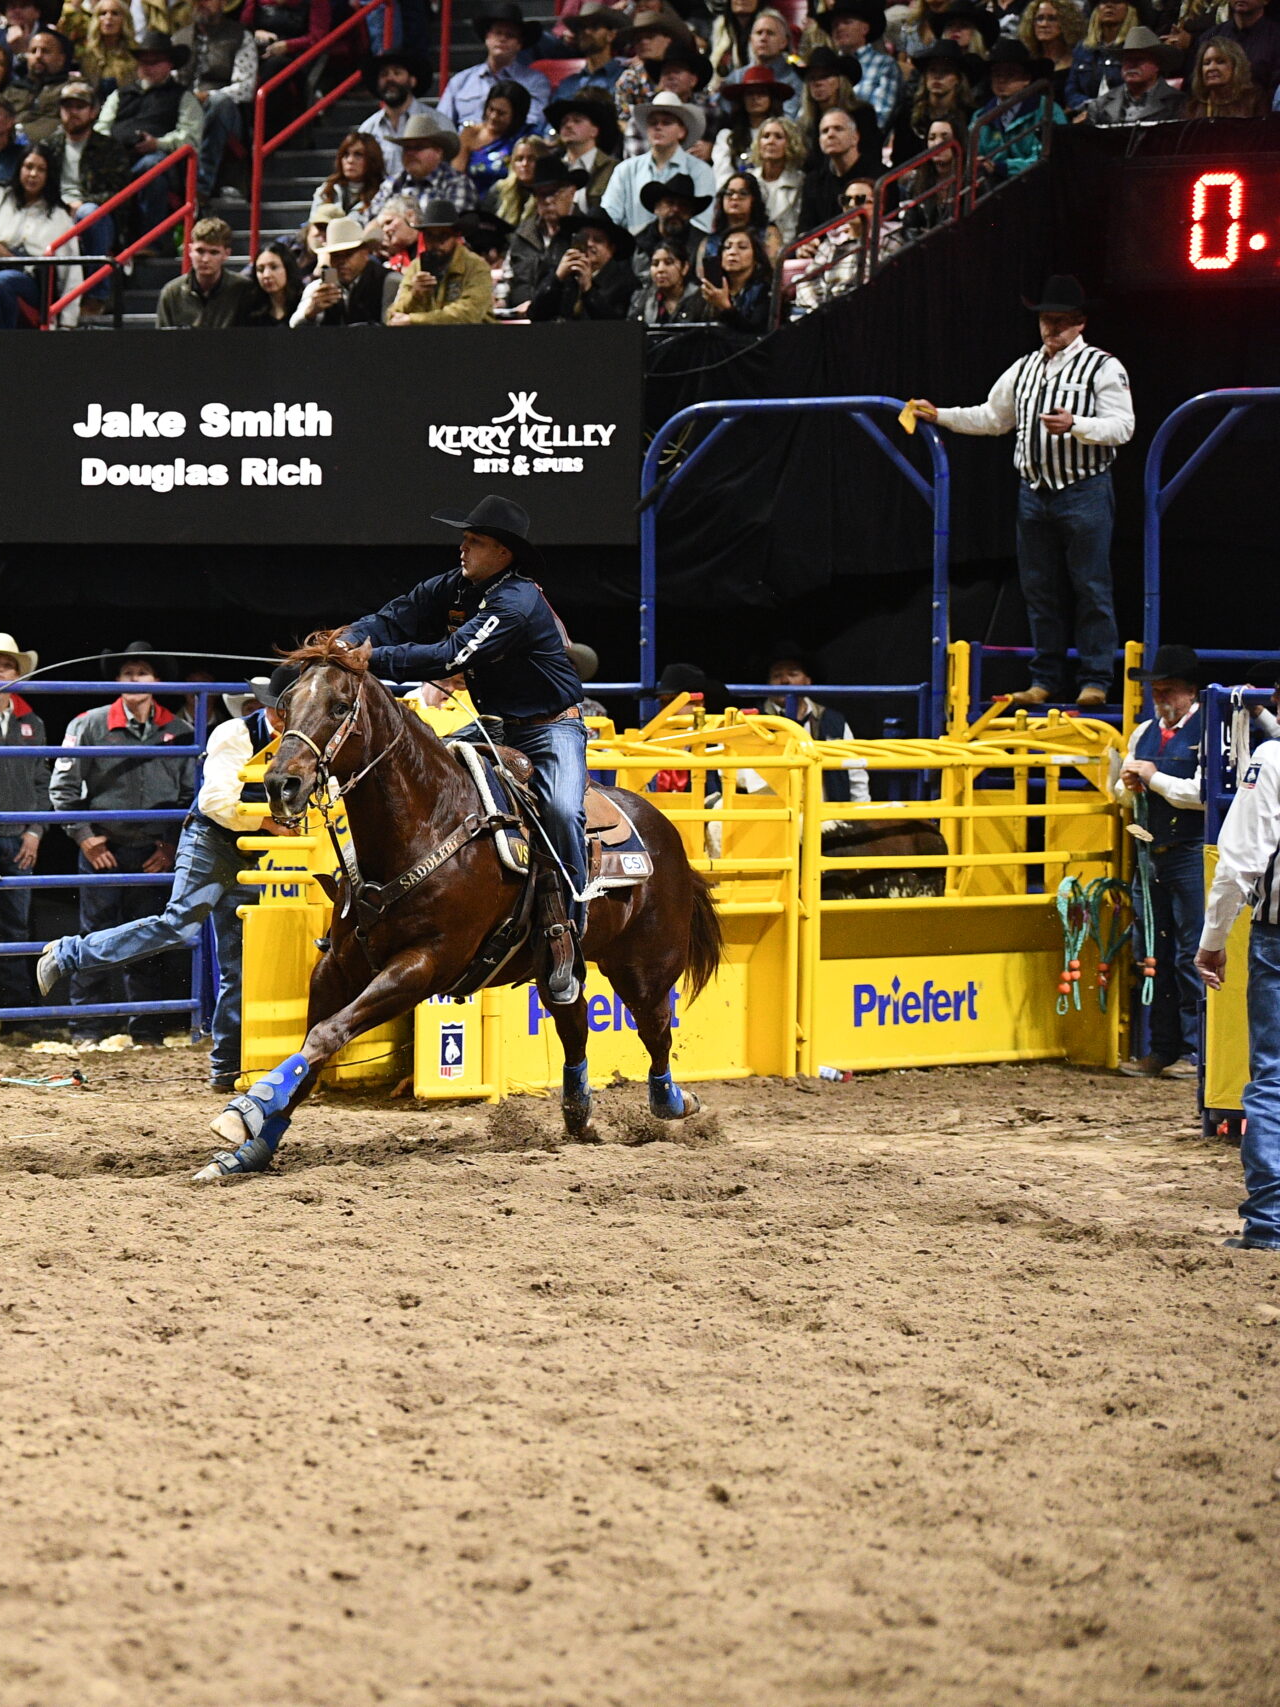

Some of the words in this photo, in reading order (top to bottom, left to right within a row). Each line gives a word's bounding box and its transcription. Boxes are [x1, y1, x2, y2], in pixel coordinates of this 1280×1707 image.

[73, 403, 186, 437] Jake
[199, 402, 332, 437] Smith
[428, 424, 515, 456] KERRY
[520, 423, 617, 455] KELLEY
[81, 457, 229, 493] Douglas
[240, 457, 322, 486] Rich
[473, 457, 510, 473] BITS
[511, 454, 530, 476] &
[532, 456, 583, 473] SPURS
[445, 615, 500, 671] CINCH
[622, 856, 645, 870] CSI
[853, 974, 978, 1028] Priefert
